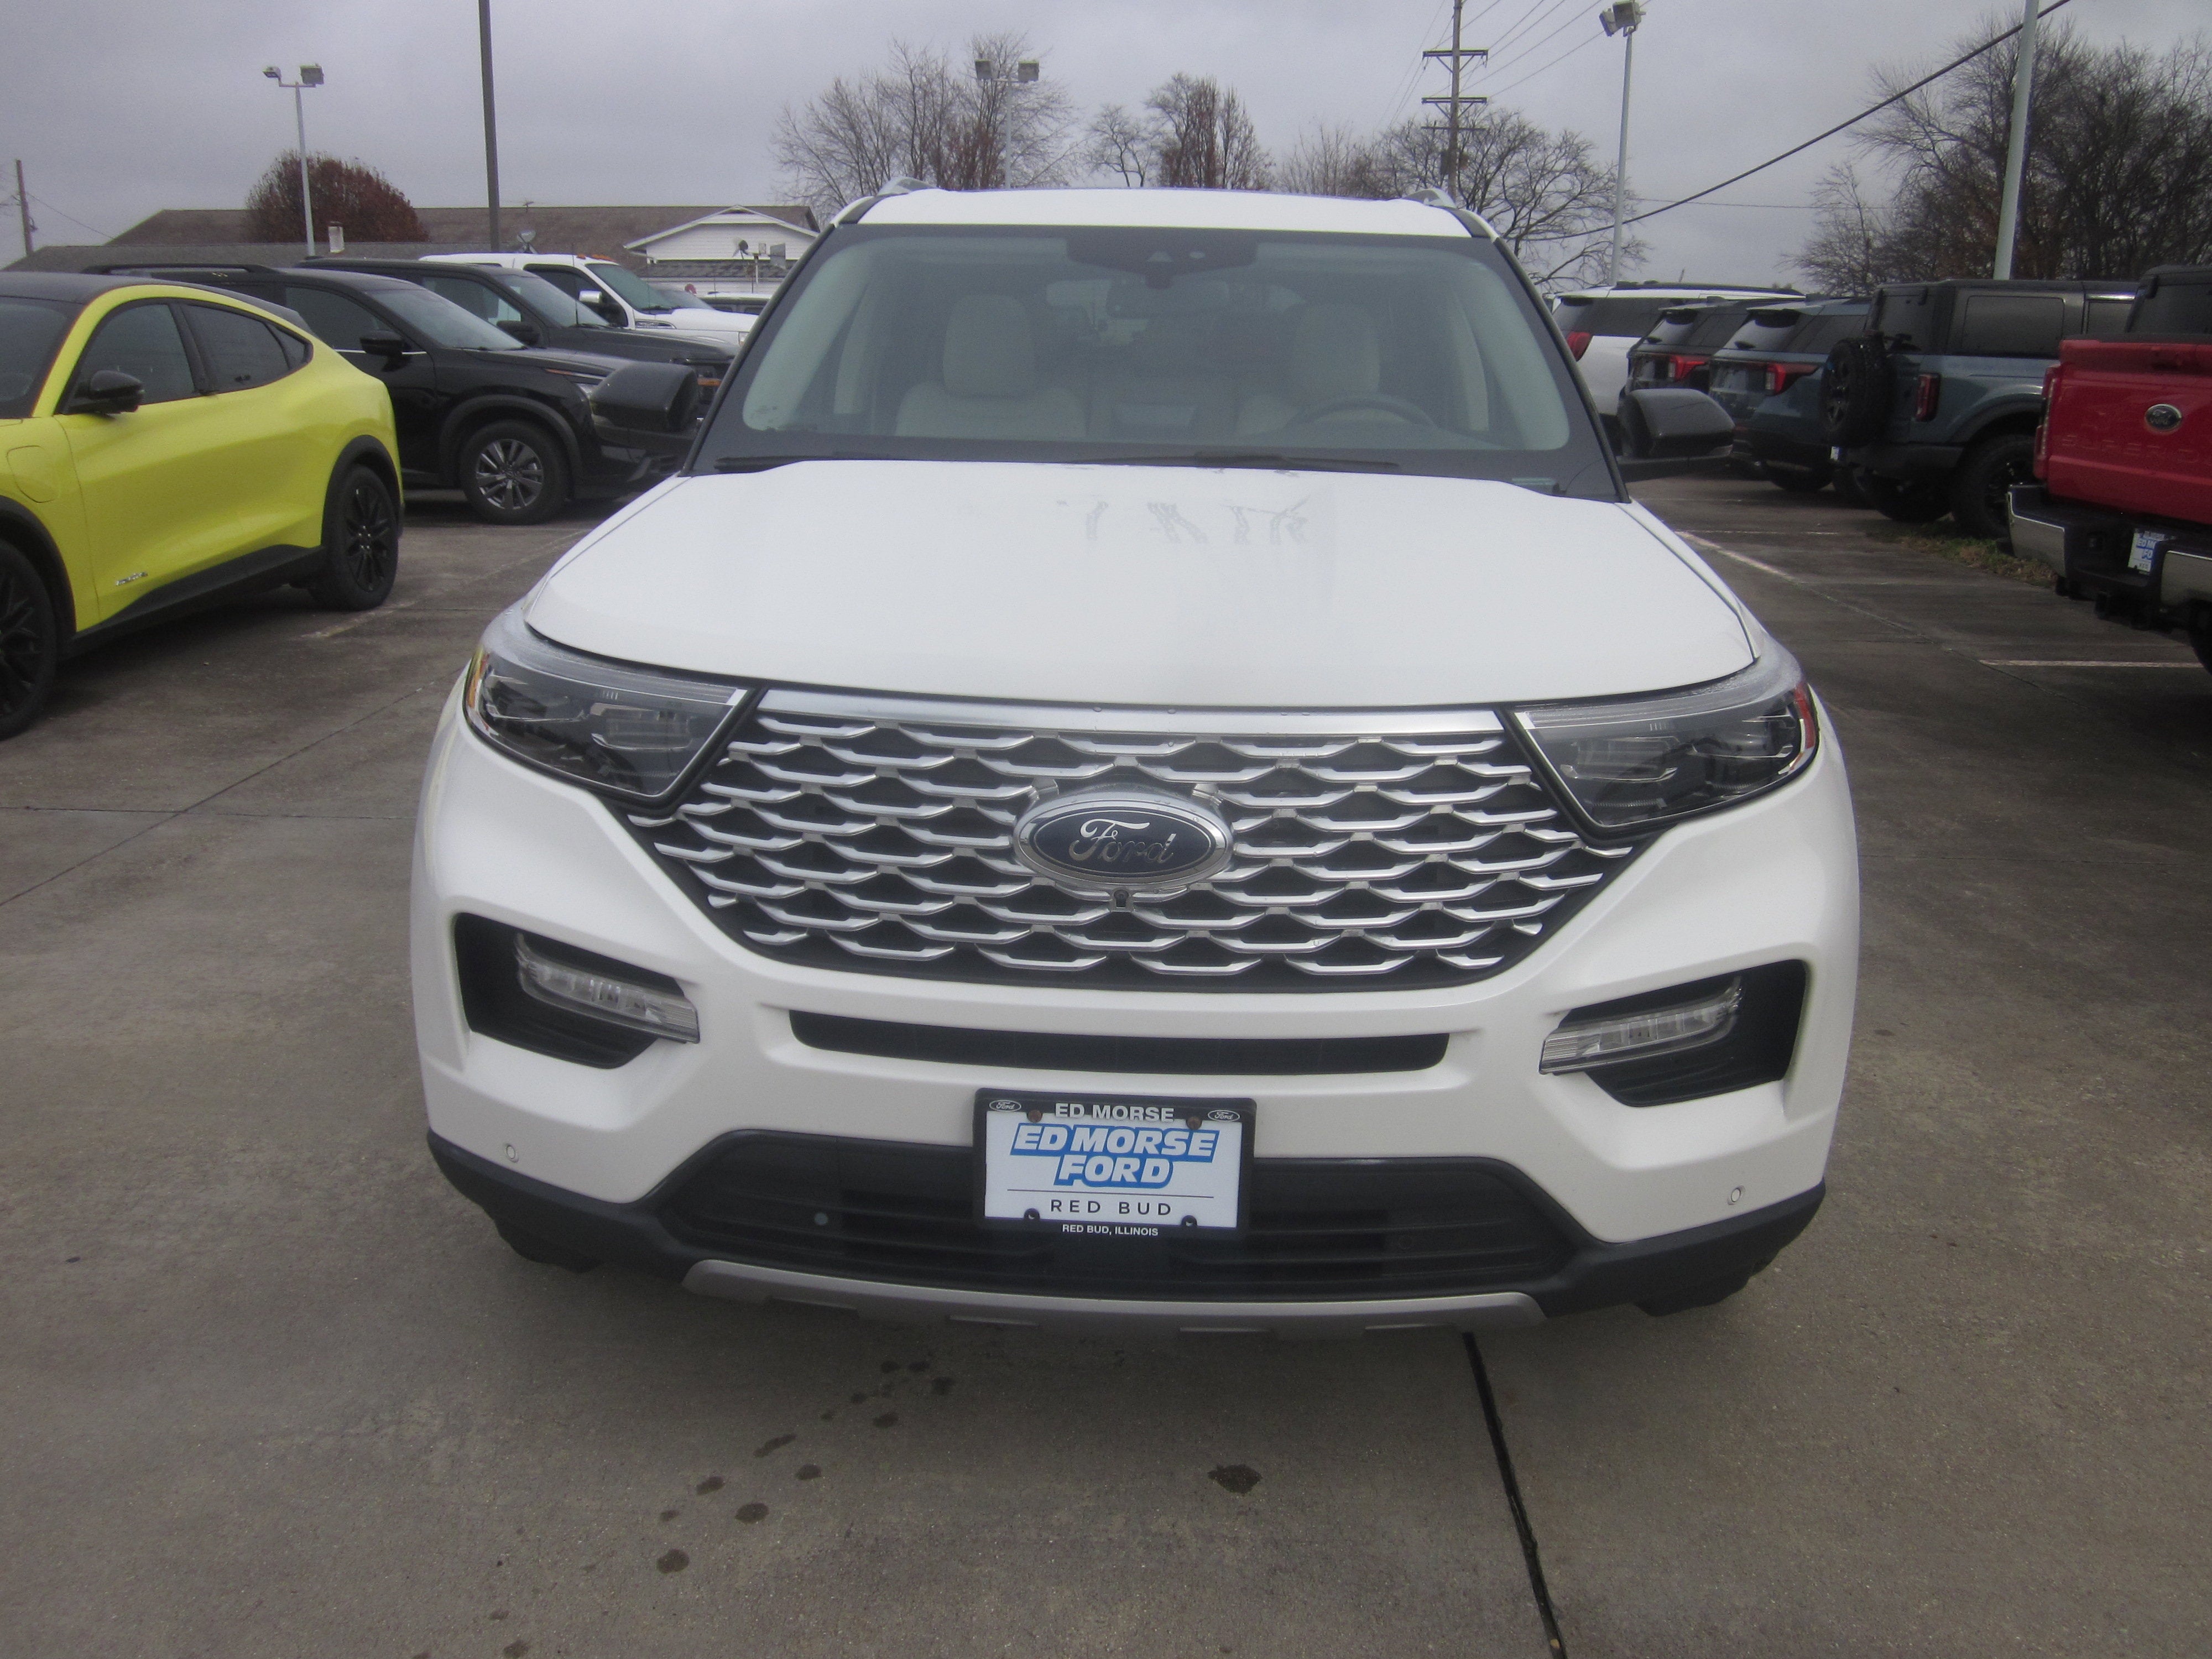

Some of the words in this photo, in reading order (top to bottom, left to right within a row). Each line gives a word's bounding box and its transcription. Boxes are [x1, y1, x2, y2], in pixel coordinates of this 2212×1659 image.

[1069, 818, 1176, 863] Ford
[995, 1101, 1015, 1110] Ford
[1056, 1103, 1084, 1118] ED
[1093, 1104, 1174, 1122] MORSE
[1214, 1112, 1233, 1120] Ford
[1057, 1154, 1171, 1183] FORD
[1051, 1199, 1101, 1213] RED
[1119, 1201, 1171, 1215] BUD
[1062, 1224, 1084, 1233] RED
[1087, 1224, 1112, 1235] BUD,
[1115, 1226, 1159, 1237] ILLINOIS
